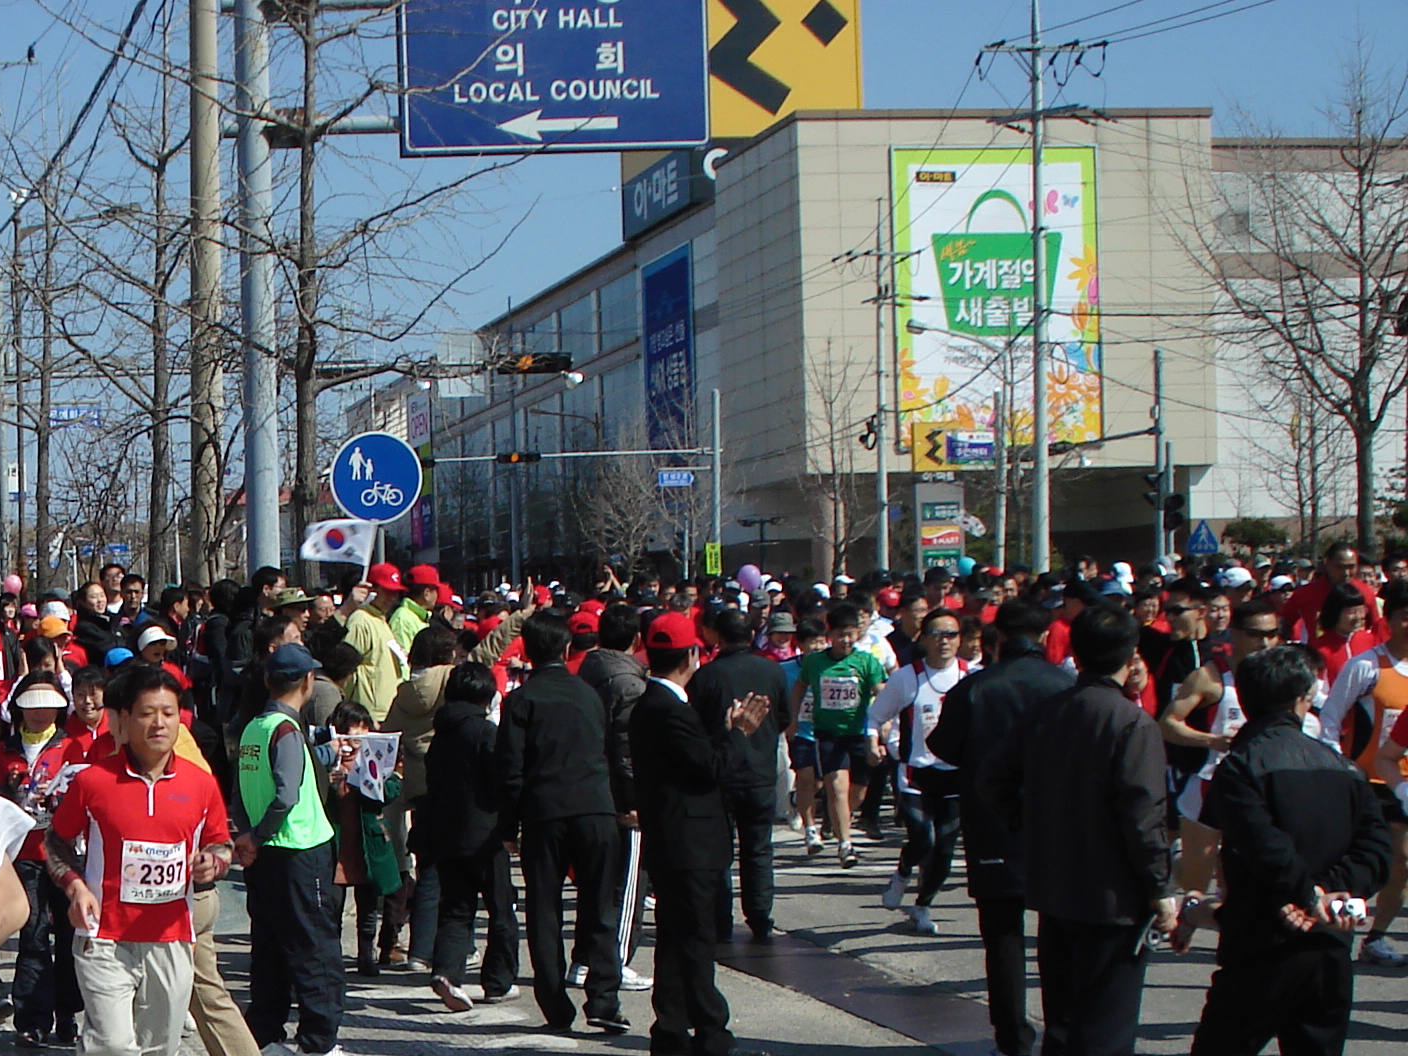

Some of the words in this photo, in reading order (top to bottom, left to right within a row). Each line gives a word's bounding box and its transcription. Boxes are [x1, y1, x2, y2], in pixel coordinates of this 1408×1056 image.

[492, 8, 548, 31] CITY
[558, 7, 623, 29] HALL
[495, 42, 524, 77] 의
[595, 40, 624, 75] 회
[453, 80, 540, 104] LOCAL
[550, 78, 660, 101] COUNCIL
[410, 411, 428, 439] OPEN
[927, 557, 957, 567] fresh
[829, 689, 857, 700] 2736
[145, 843, 182, 857] megaTV
[139, 861, 184, 885] 2397
